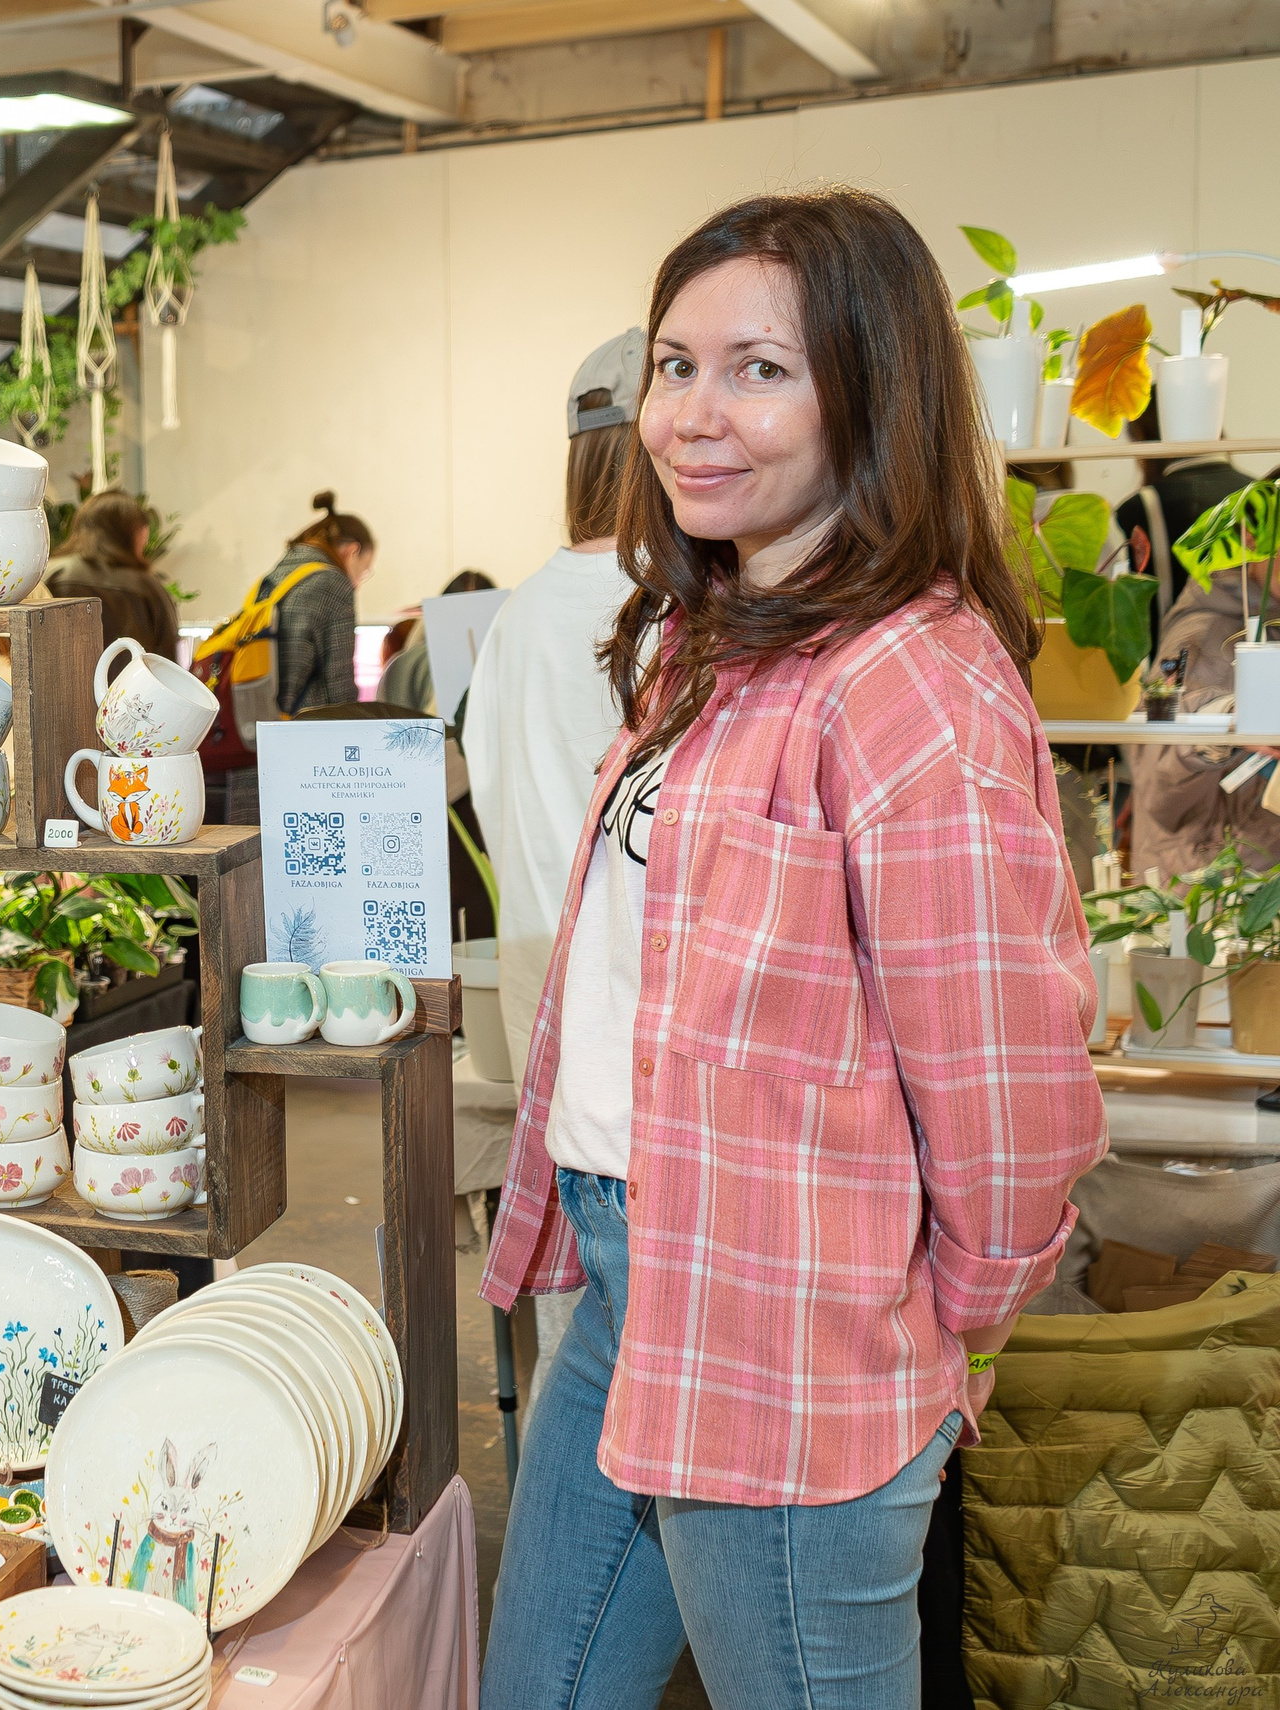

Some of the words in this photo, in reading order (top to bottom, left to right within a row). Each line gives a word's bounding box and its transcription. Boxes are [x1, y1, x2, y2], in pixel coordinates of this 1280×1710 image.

[312, 766, 392, 778] FAZA.OBJIGA
[299, 782, 351, 790] МАСТЕРСКАЯ
[353, 781, 406, 789] ПРИРОДНОЙ
[331, 791, 375, 799] КЕРАМИКИ
[47, 828, 74, 839] 2000
[290, 880, 343, 889] FAZA.OBJIGA
[366, 881, 421, 890] FAZA.OBJIGA
